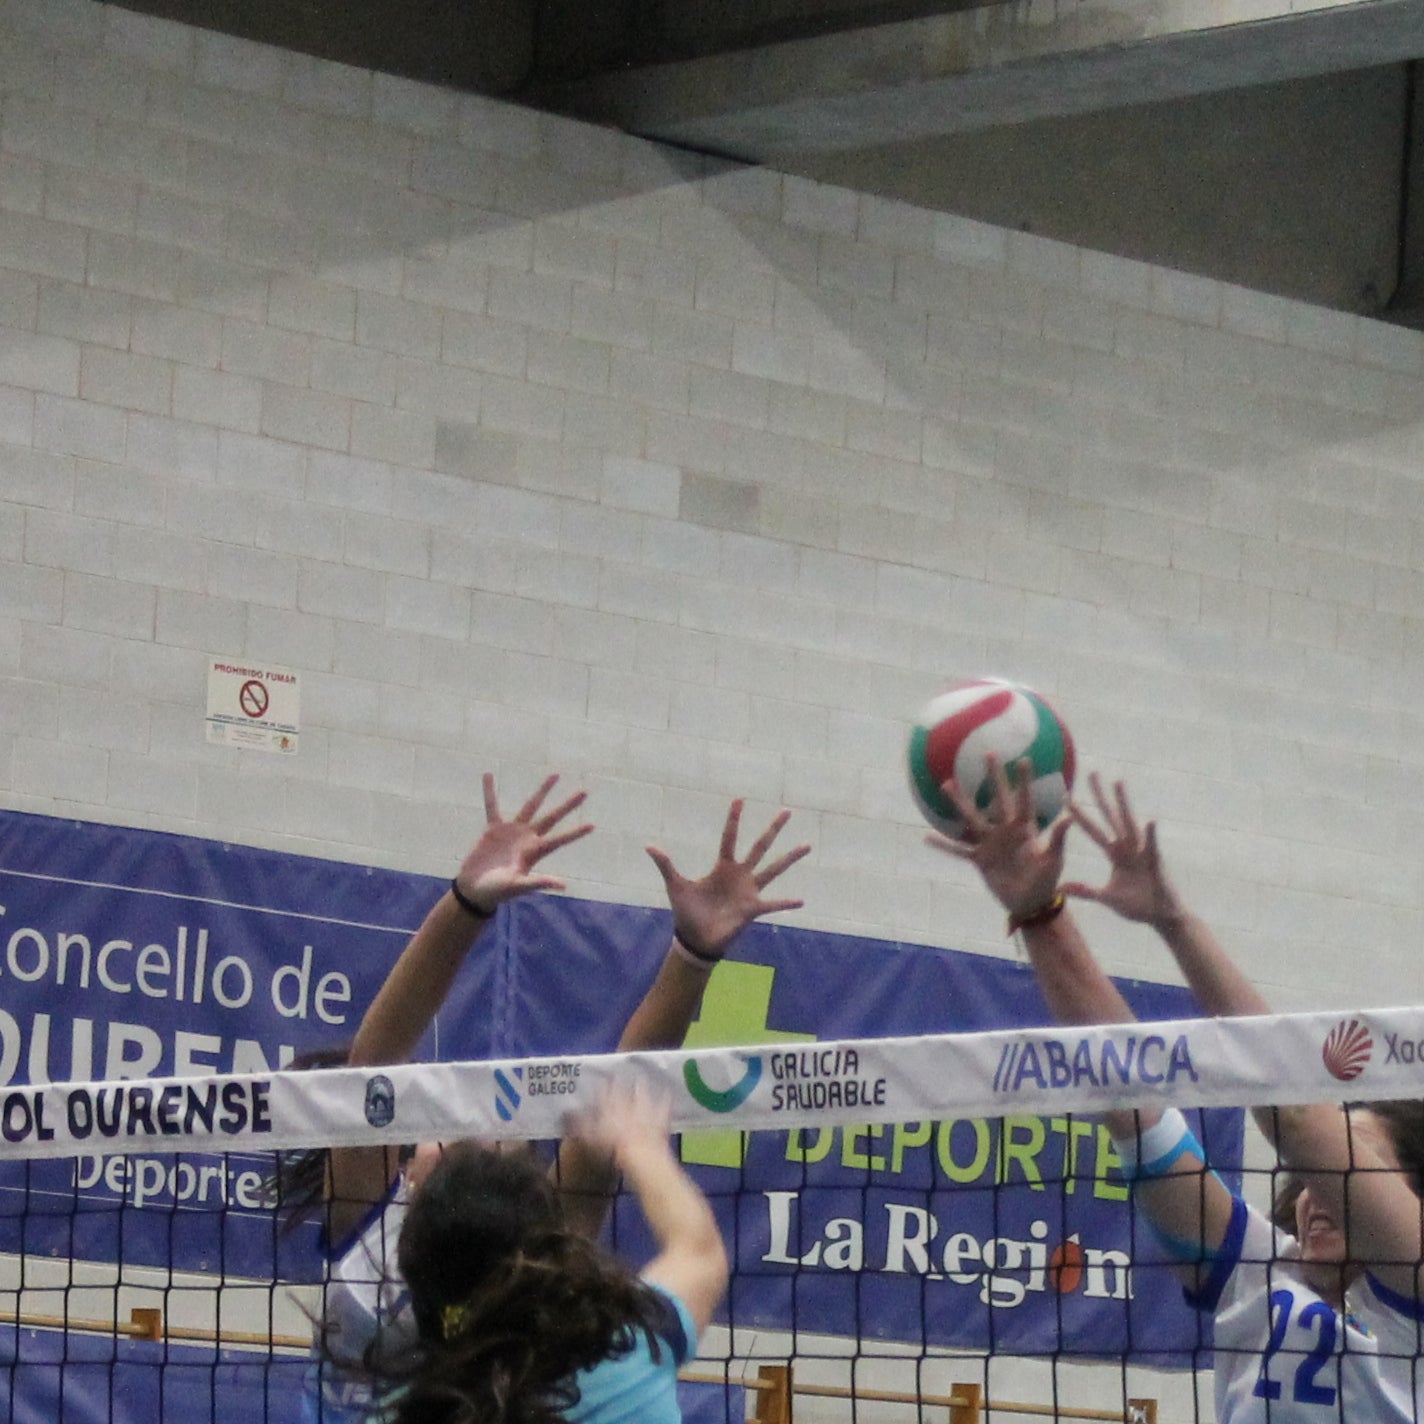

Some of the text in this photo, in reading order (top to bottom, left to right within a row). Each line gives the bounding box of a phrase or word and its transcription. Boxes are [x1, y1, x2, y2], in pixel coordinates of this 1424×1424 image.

[214, 664, 263, 679] PROHIBIDO
[271, 945, 352, 1026] de
[528, 1064, 581, 1080] DEPORTE
[771, 1049, 859, 1079] GALICIA
[528, 1081, 576, 1096] GALEGO
[772, 1079, 886, 1110] SAUDABLE
[67, 1081, 272, 1139] OURENSE
[761, 1190, 863, 1272] La
[1252, 1289, 1336, 1406] 22
